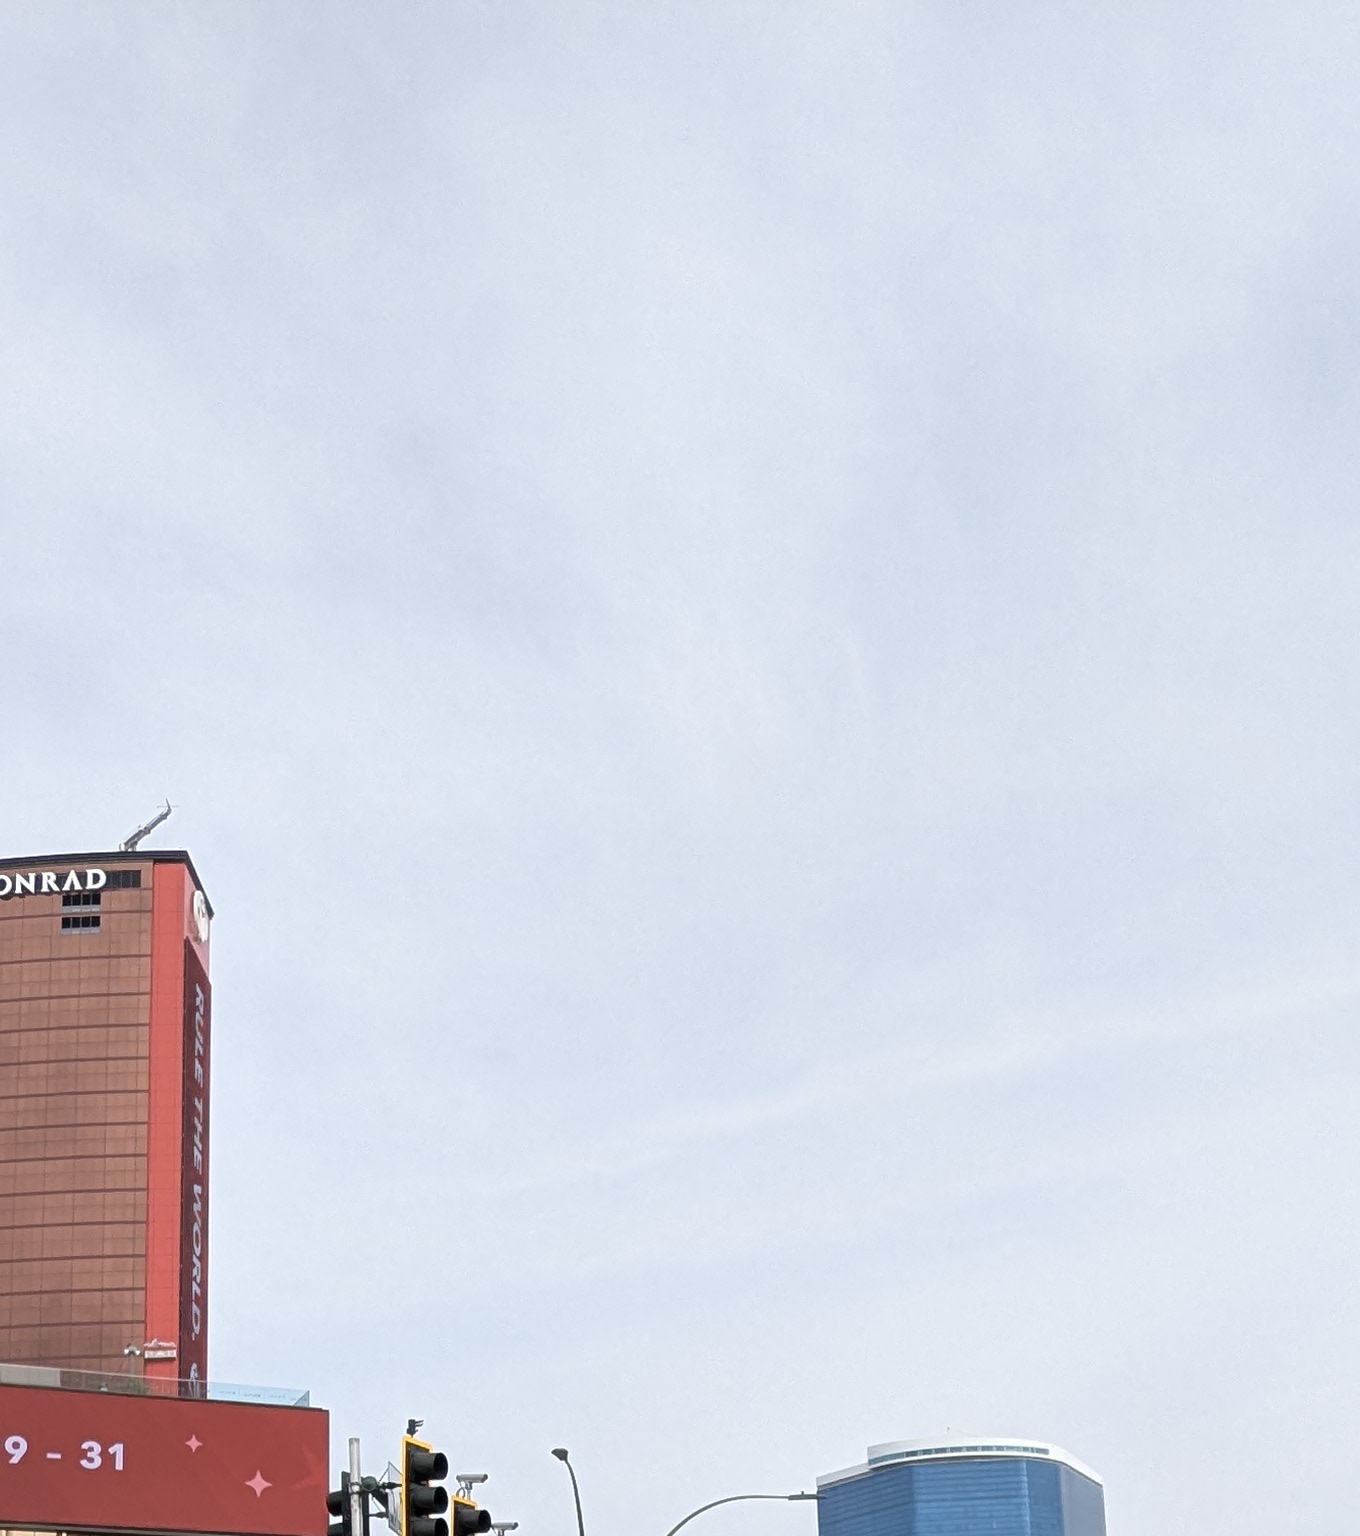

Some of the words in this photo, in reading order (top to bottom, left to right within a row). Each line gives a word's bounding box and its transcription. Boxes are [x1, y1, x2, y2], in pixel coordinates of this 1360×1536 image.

[194, 982, 205, 1089] RULE
[192, 1097, 204, 1175] THE
[80, 1441, 124, 1471] 31
